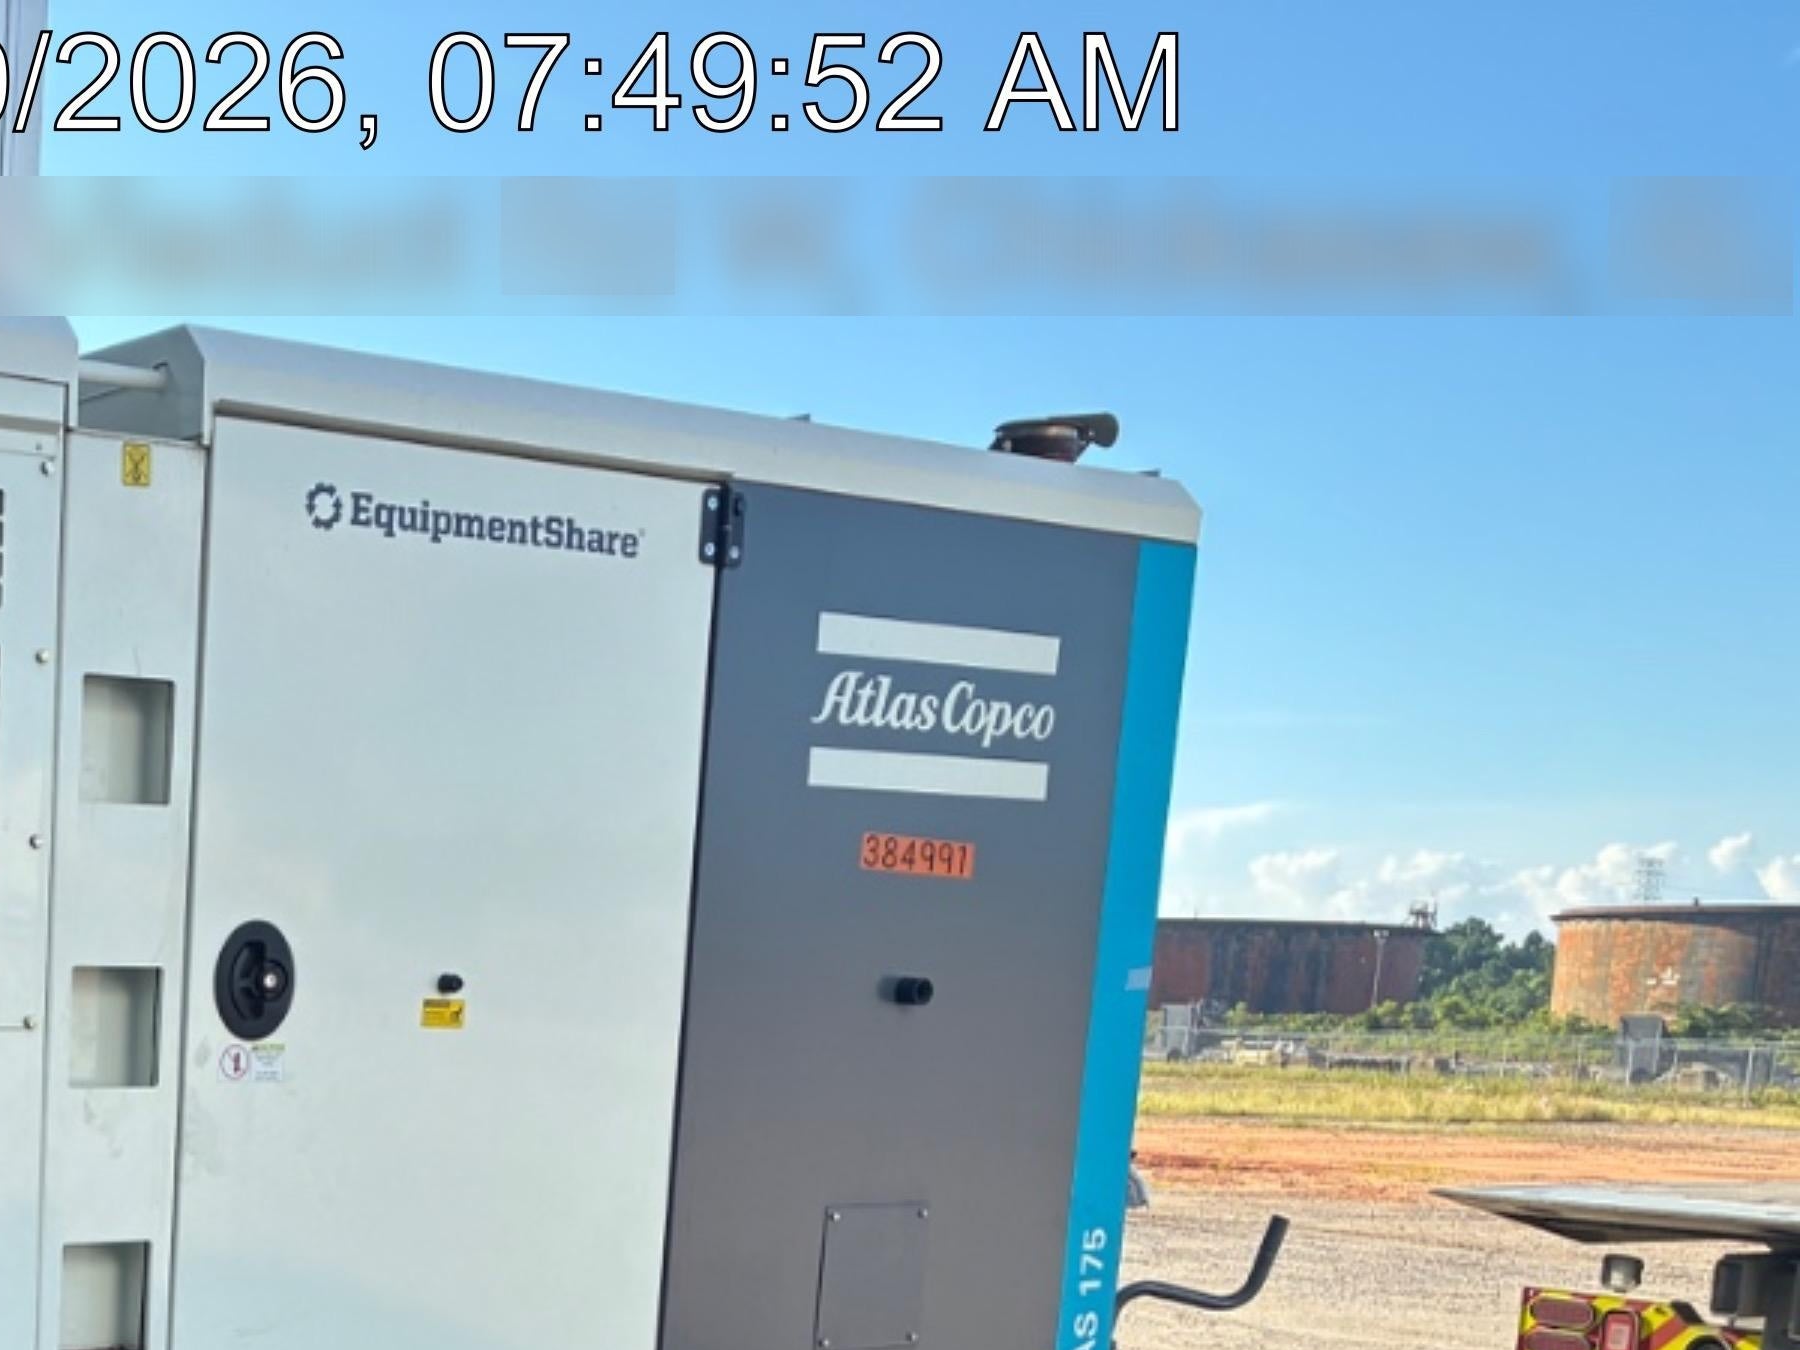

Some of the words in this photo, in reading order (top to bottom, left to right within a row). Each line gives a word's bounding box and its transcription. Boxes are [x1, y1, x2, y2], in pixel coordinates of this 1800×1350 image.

[351, 492, 639, 558] EquipmentShare
[810, 671, 940, 734] Atlas
[942, 680, 1056, 748] Copco
[863, 834, 968, 875] 384991
[1079, 1228, 1108, 1296] 175
